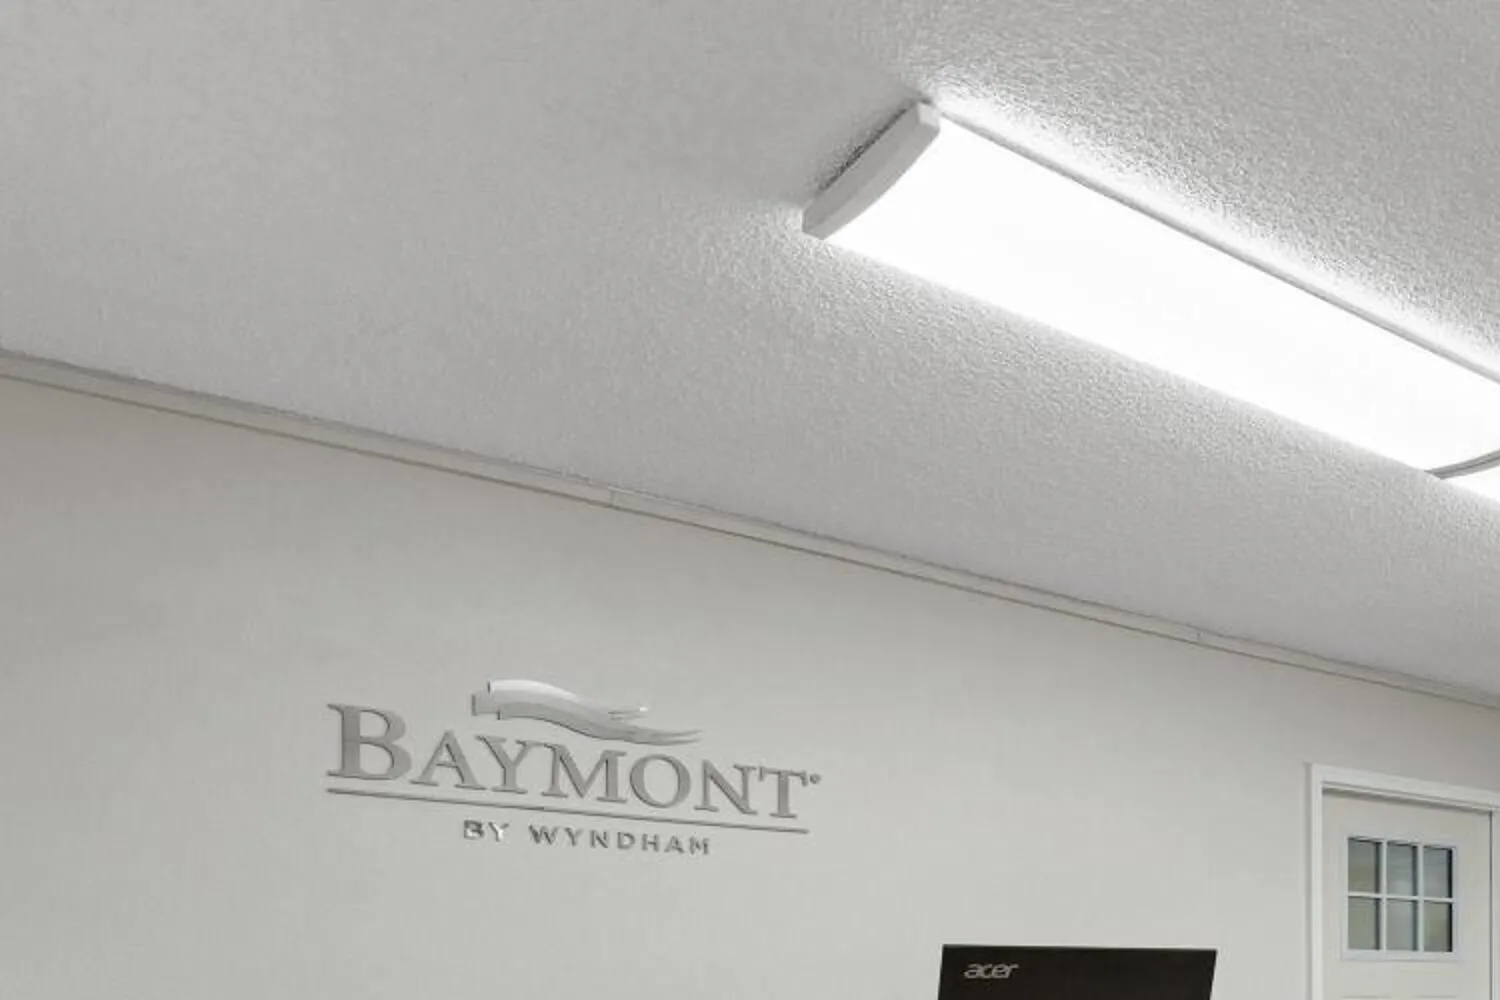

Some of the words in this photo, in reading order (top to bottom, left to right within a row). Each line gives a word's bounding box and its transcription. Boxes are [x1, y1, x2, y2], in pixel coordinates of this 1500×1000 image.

[326, 703, 809, 818] BAYMONT
[462, 819, 509, 842] BY
[528, 824, 713, 855] WYNDHAM
[963, 963, 1019, 979] acer
